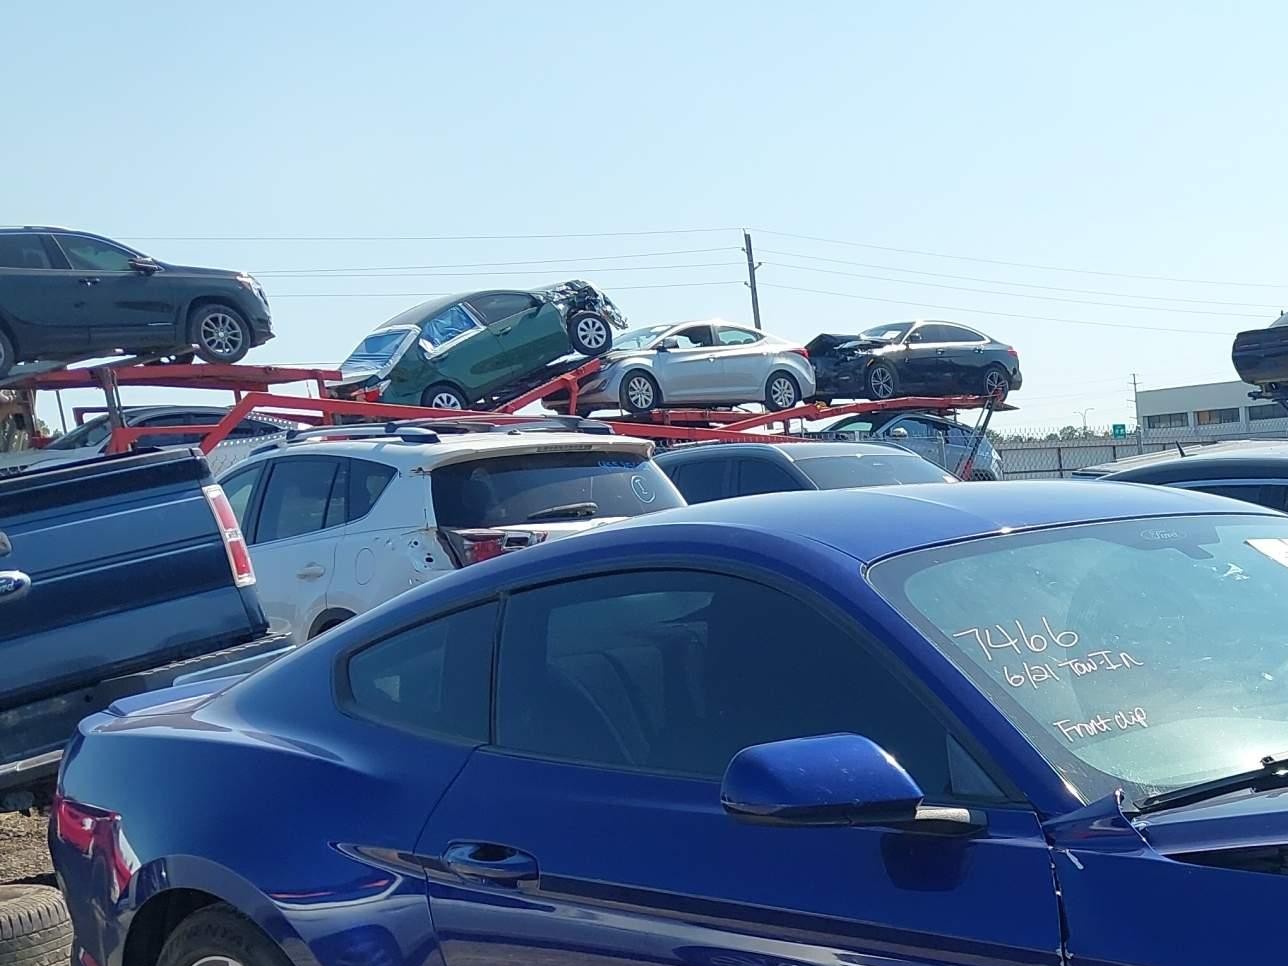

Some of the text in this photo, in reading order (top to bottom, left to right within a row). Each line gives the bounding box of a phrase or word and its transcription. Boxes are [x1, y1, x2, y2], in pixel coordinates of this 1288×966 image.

[953, 617, 1079, 661] 7466
[1004, 661, 1060, 689] 6/21
[1053, 717, 1114, 742] Front
